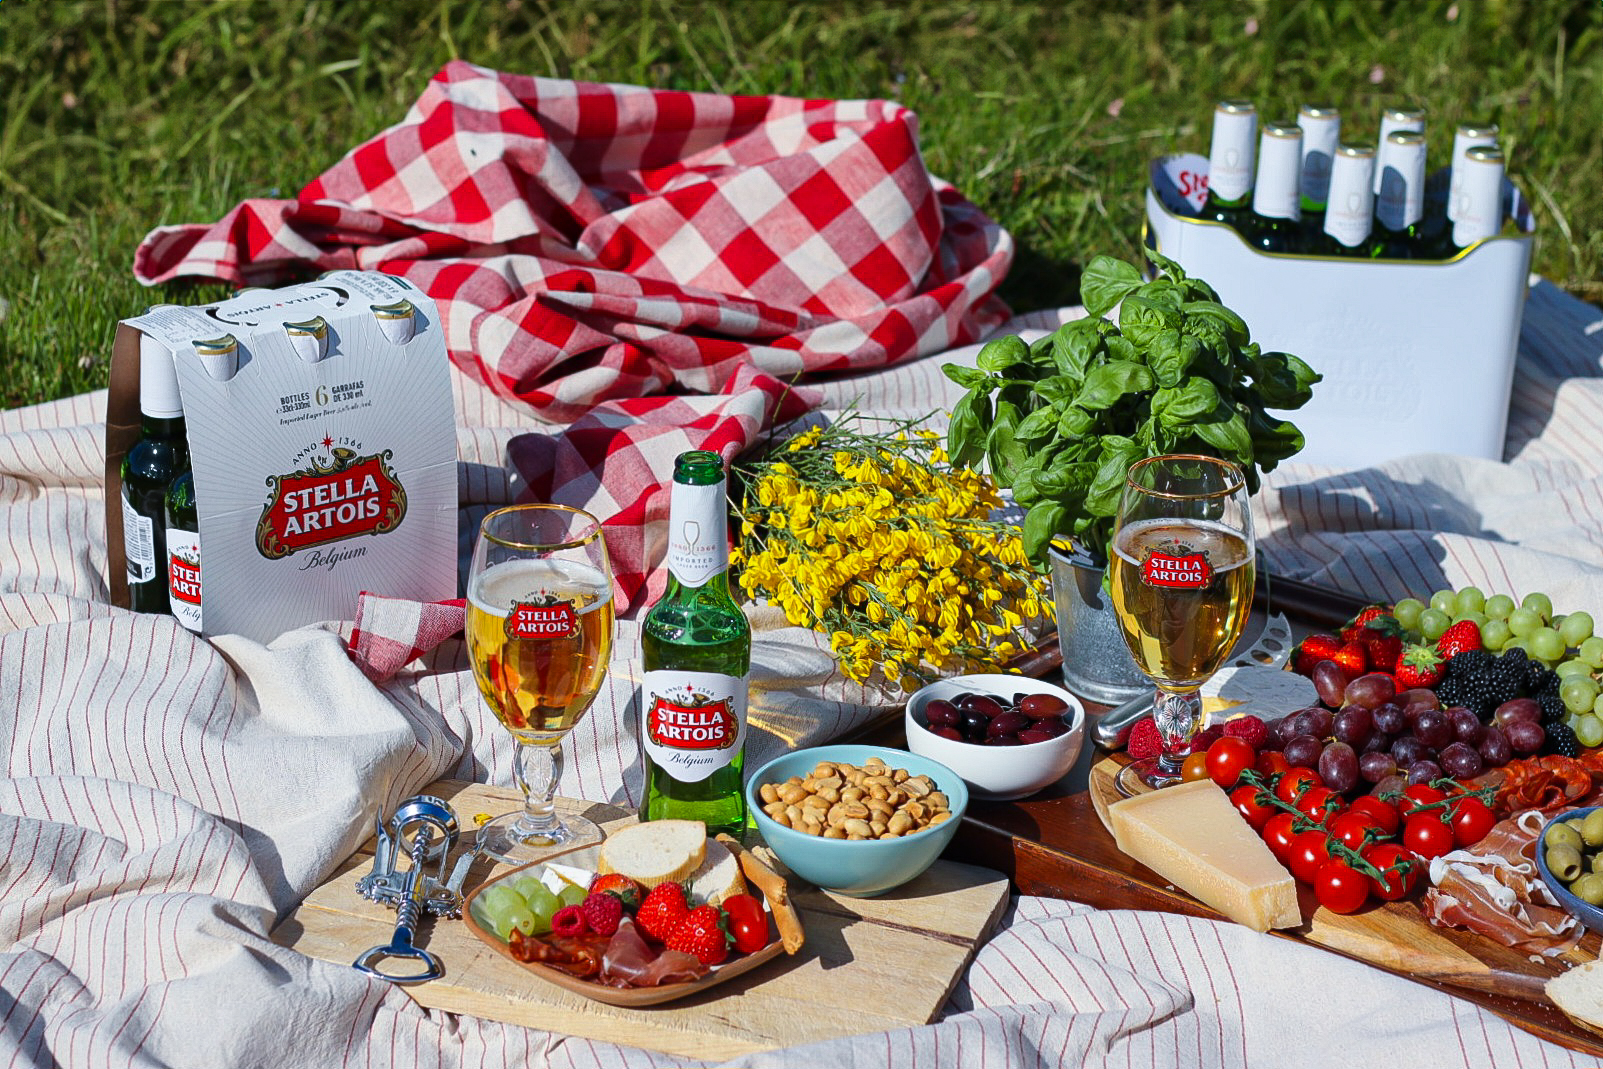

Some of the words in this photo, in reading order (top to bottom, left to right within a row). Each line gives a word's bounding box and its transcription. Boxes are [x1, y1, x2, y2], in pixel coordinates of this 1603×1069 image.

[315, 385, 329, 406] 6
[331, 381, 364, 394] GARRAFAS
[280, 392, 310, 405] BOTTLES
[292, 442, 318, 465] ANNO
[339, 437, 362, 449] 1366
[283, 473, 380, 513] STELLA
[283, 496, 380, 537] ARTOIS
[299, 546, 368, 571] Belgium
[1151, 558, 1202, 571] STELLA
[1150, 569, 1203, 582] ARTOIS
[172, 577, 201, 597] ART
[517, 609, 569, 621] STELLA
[517, 621, 570, 633] ARTOIS
[657, 707, 724, 726] STELLA
[656, 723, 725, 741] ARTOIS
[667, 753, 714, 769] Belgium
